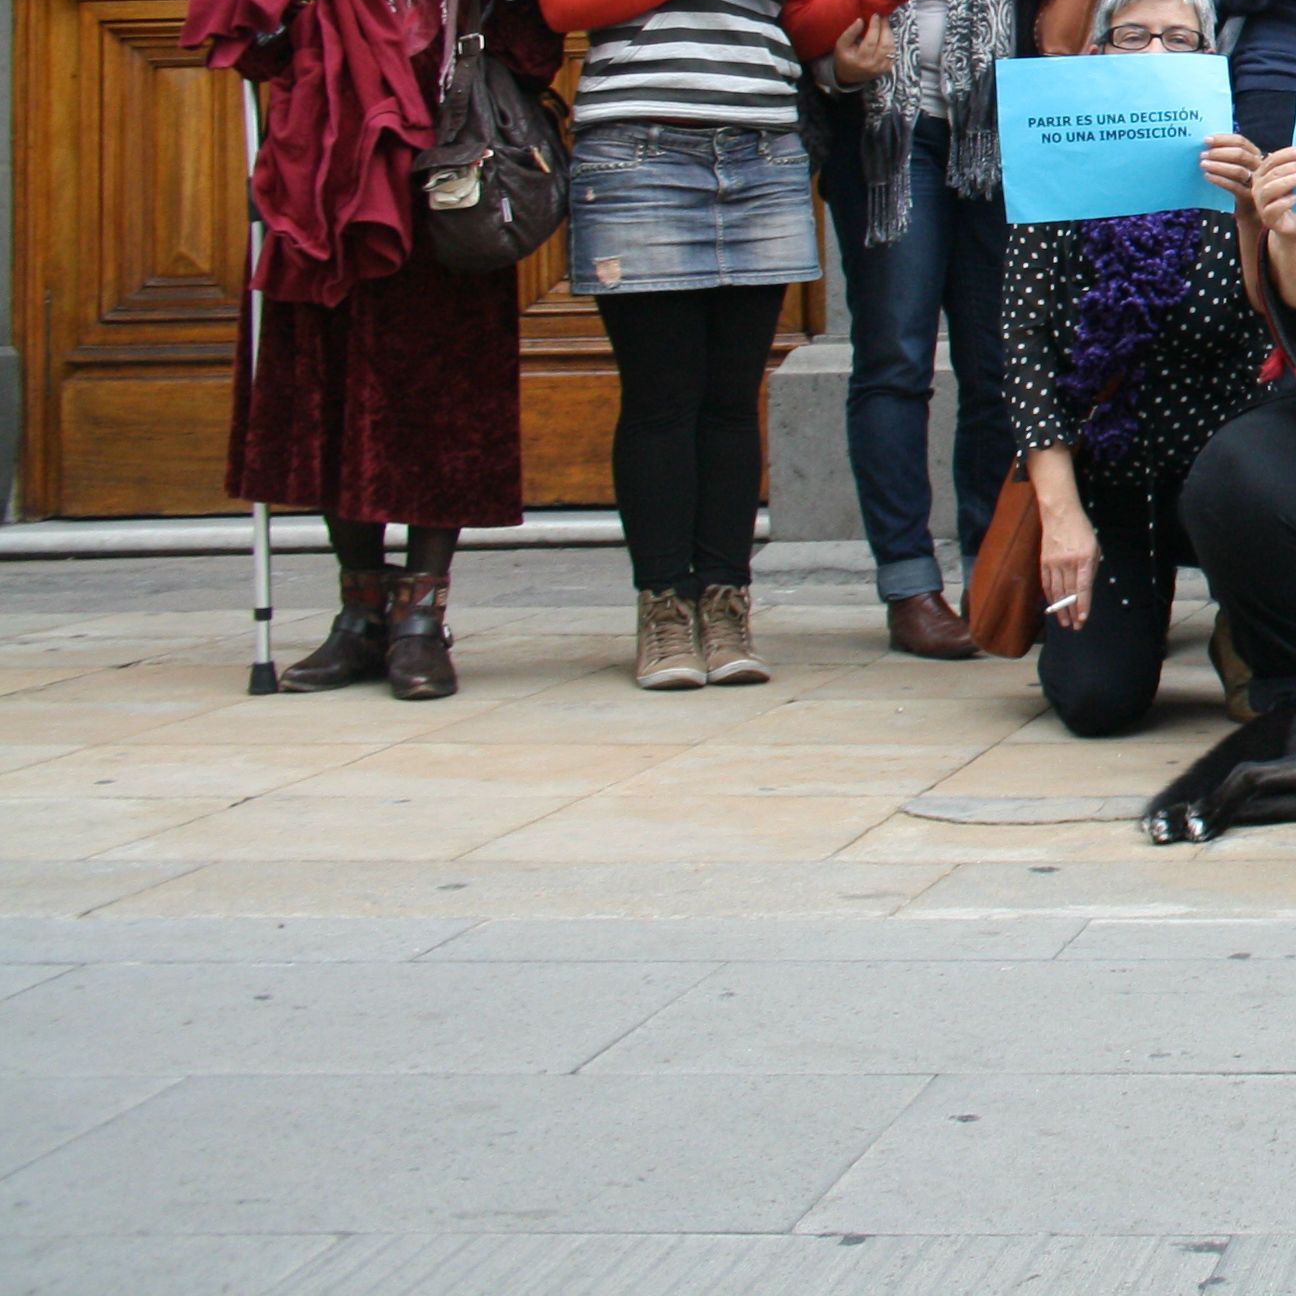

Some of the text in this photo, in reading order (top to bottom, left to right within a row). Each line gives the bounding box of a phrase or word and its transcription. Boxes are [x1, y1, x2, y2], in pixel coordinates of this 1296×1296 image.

[1028, 110, 1203, 127] PARIR ES UNA DECISIÓN,
[1042, 127, 1192, 143] NO UNA IMPOSICIÓN.
